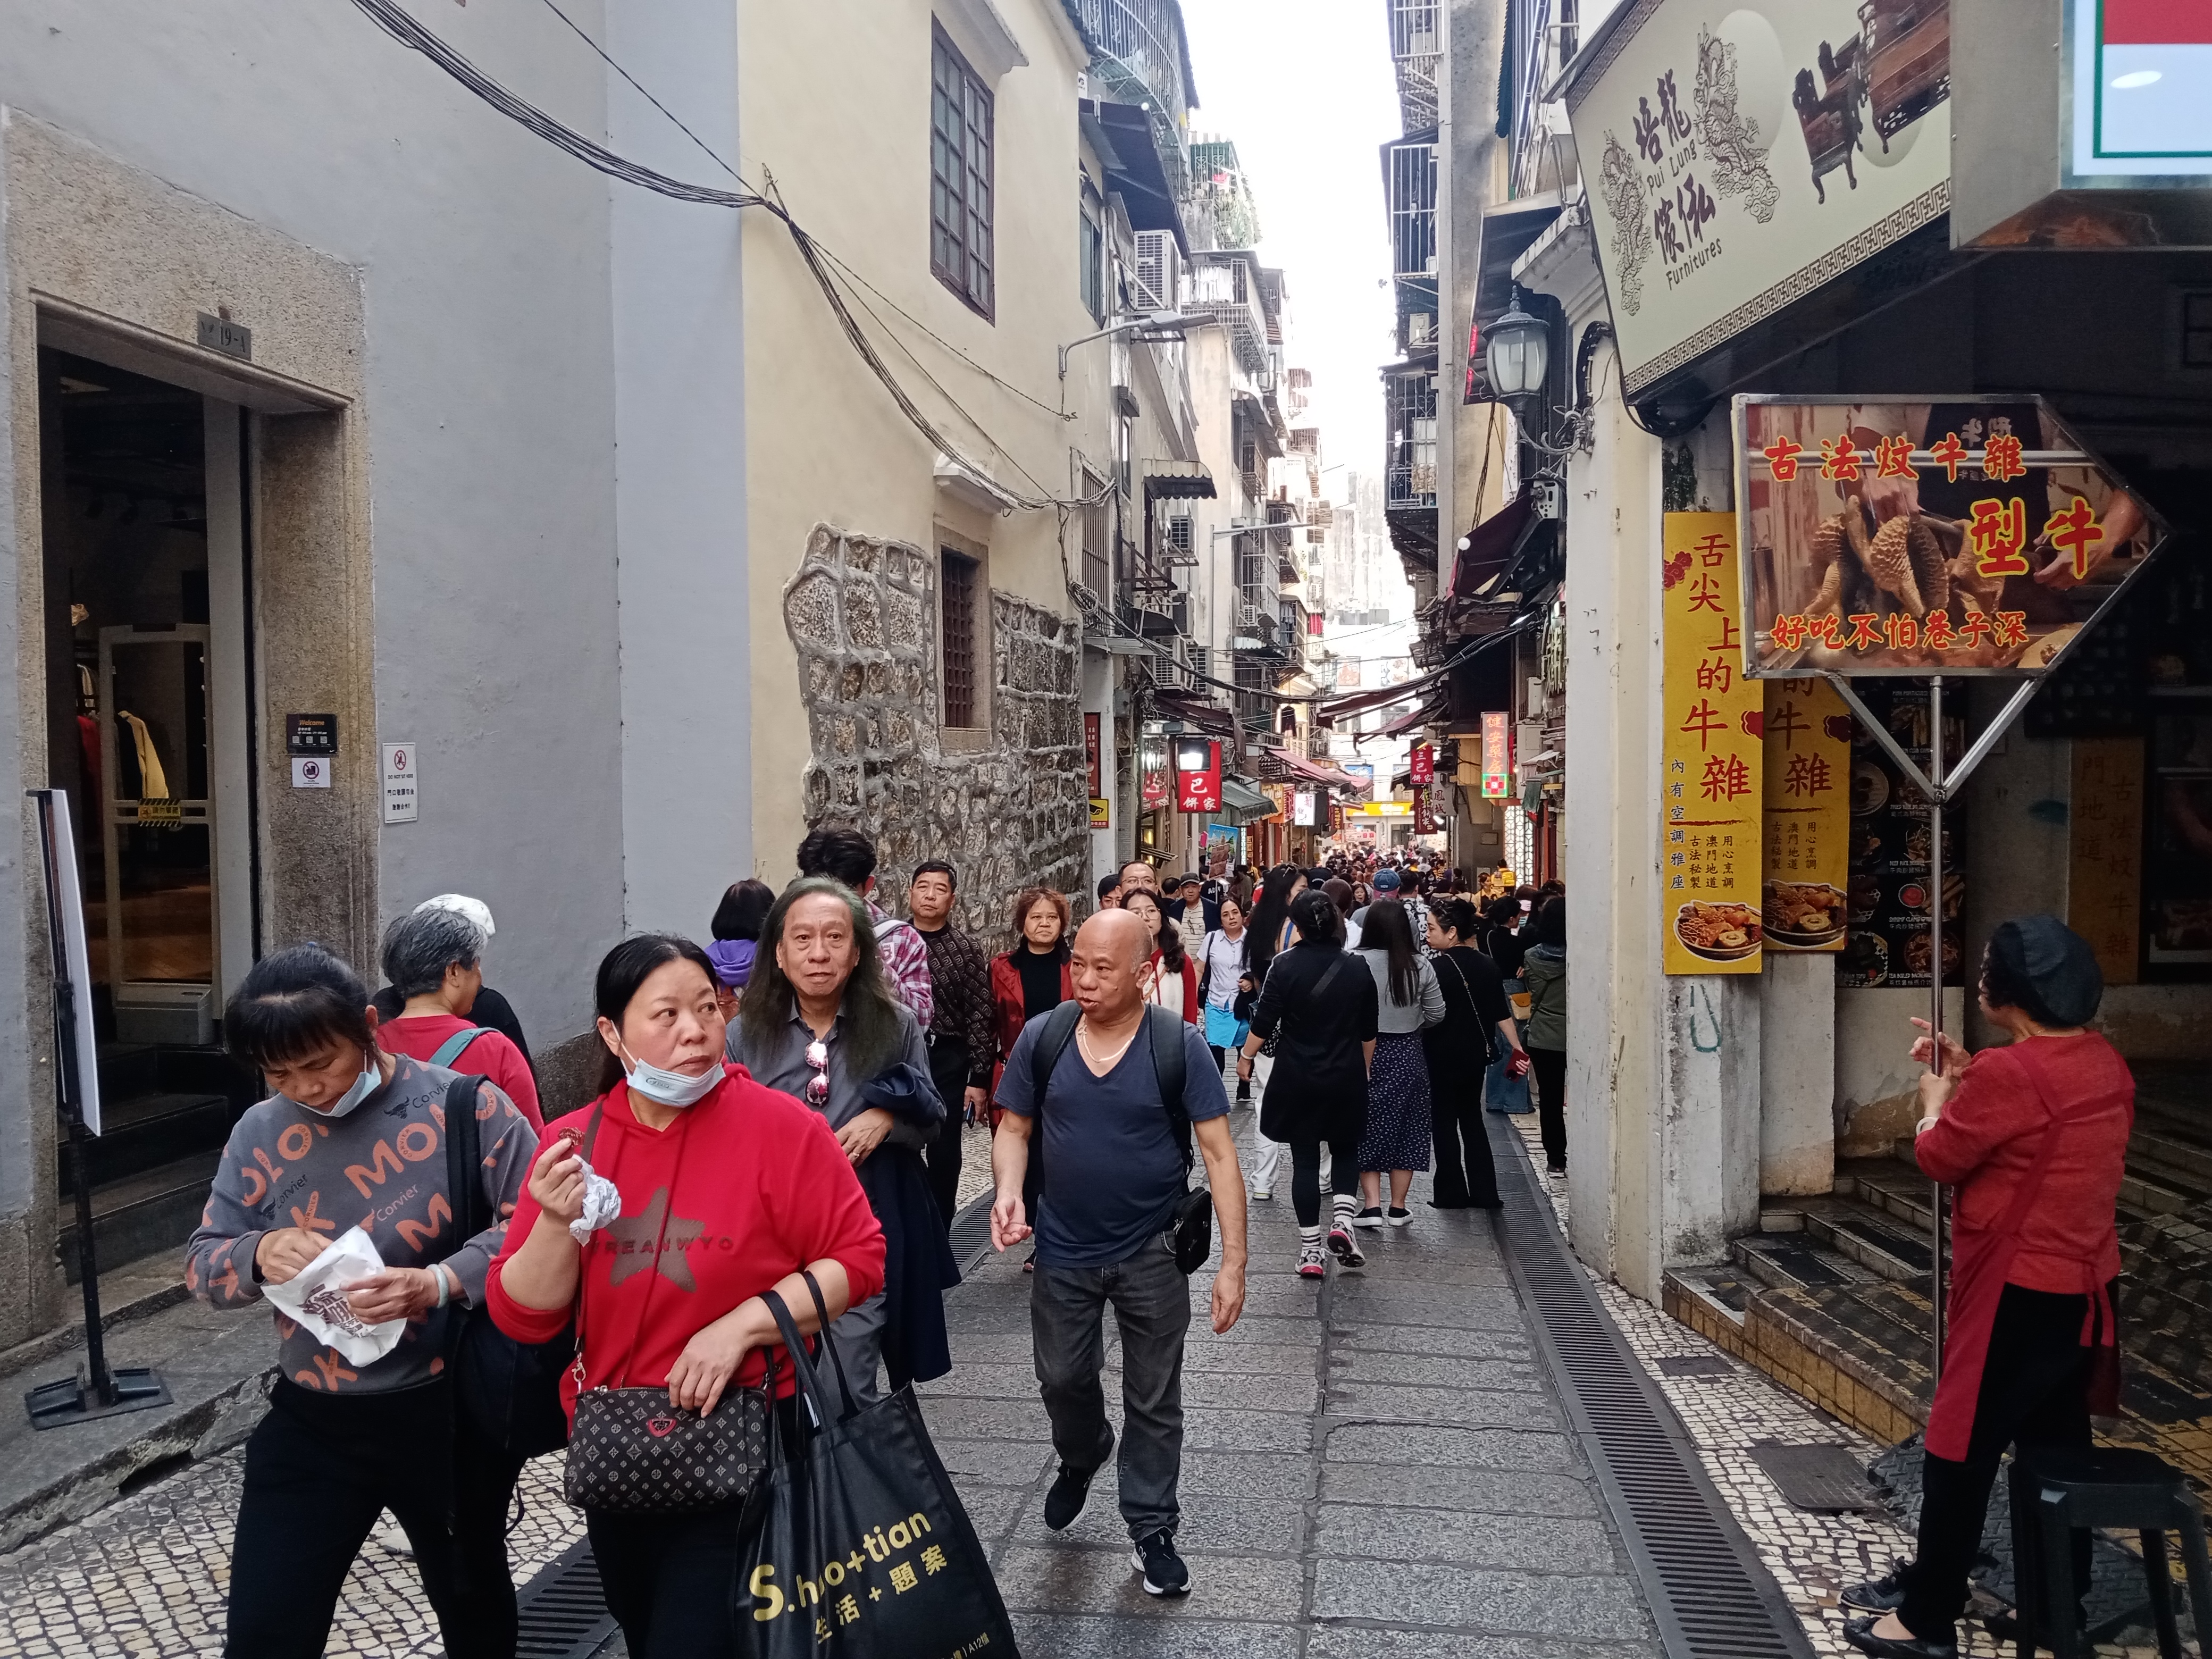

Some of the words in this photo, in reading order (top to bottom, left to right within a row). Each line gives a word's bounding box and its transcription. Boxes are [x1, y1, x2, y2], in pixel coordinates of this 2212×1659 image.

[1647, 166, 1665, 196] Pui
[1669, 139, 1697, 177] Lung
[1666, 238, 1722, 291] Furnitures
[1764, 432, 2026, 483] 古法炆牛雜
[1771, 609, 2029, 651] 好吃不怕巷子深
[1680, 533, 1753, 802] 舌尖上的牛雜
[2077, 738, 2106, 862] 門地道
[1689, 835, 1702, 889] 古法秘製
[1705, 835, 1718, 889] 澳門地道
[1722, 835, 1734, 889] 用心烹調
[376, 1184, 419, 1222] Corvier
